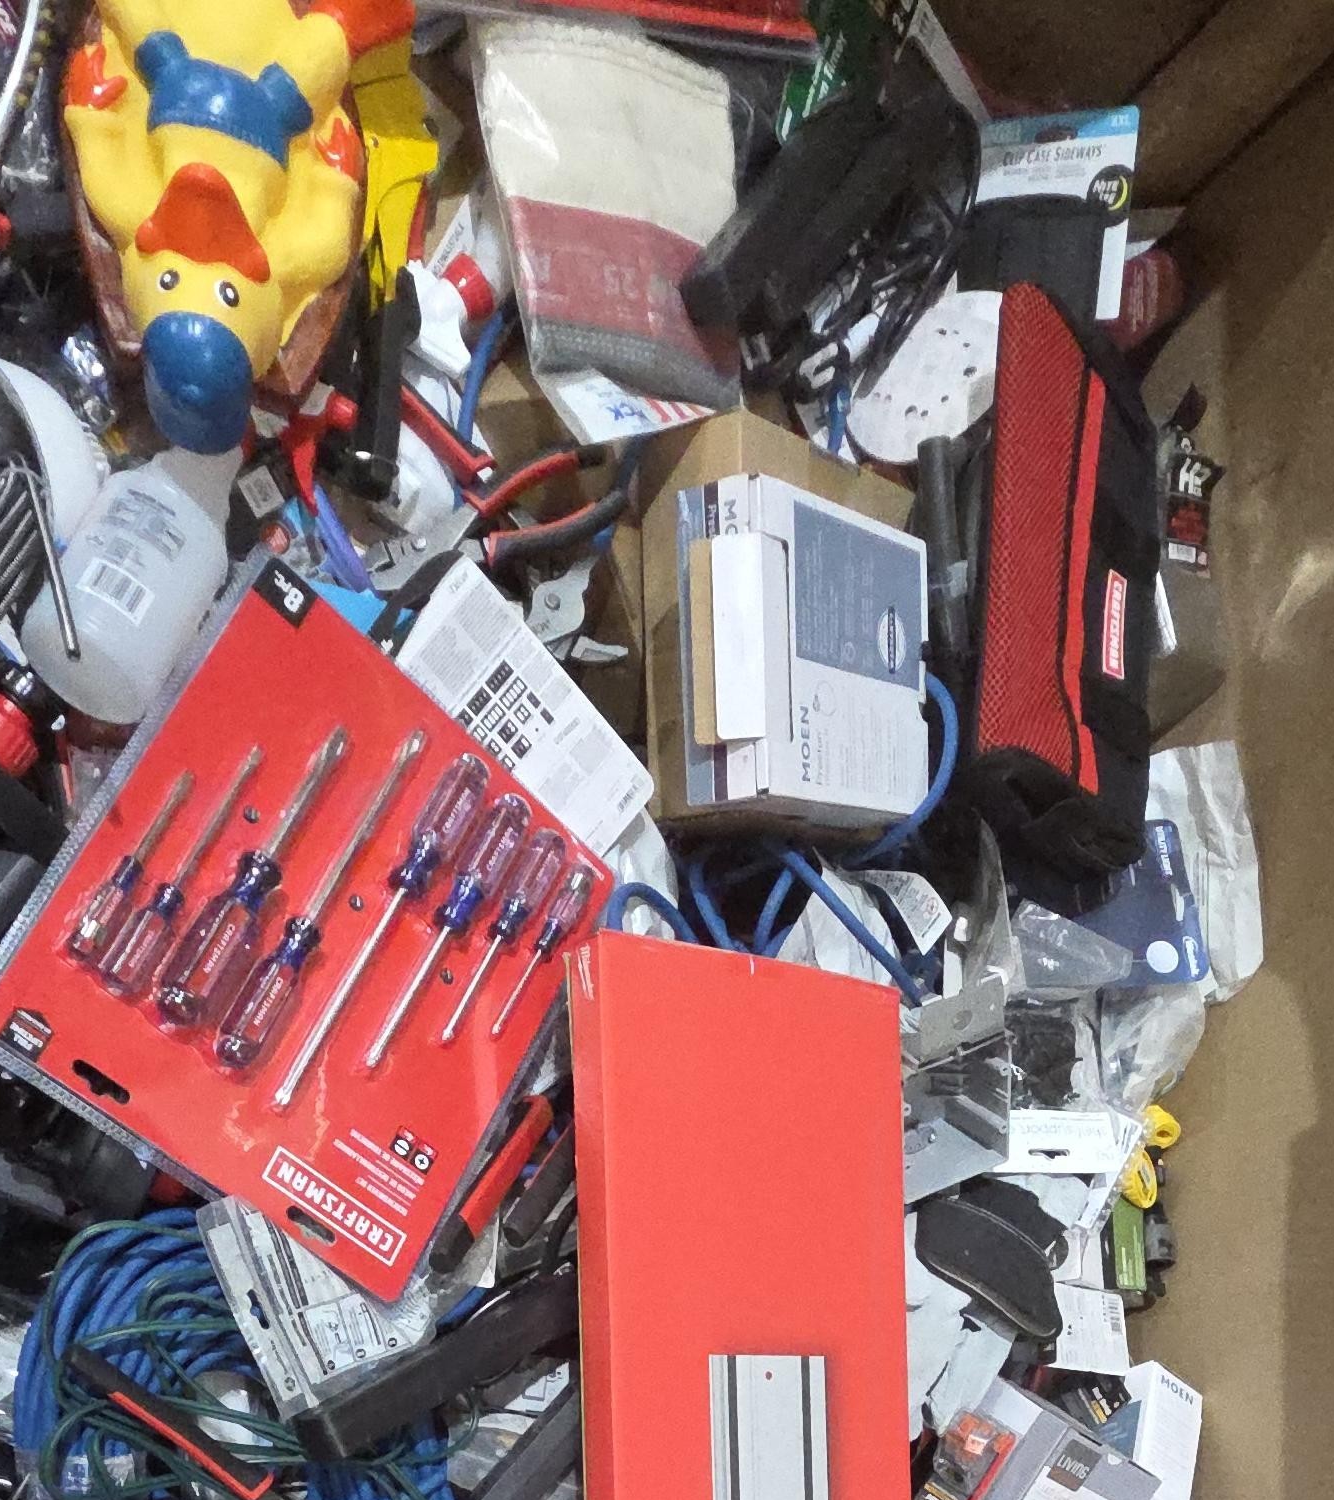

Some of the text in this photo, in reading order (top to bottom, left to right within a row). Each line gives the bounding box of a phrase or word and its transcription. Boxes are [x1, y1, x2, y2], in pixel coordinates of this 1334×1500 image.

[1109, 581, 1122, 668] CRAFTSMAN
[799, 706, 810, 781] MOEN
[201, 922, 236, 974] CRAFTSMAN
[250, 976, 285, 1027] CRAFTSMAN
[275, 1160, 394, 1252] CRAFTSMAN
[1159, 1374, 1195, 1405] MOEN
